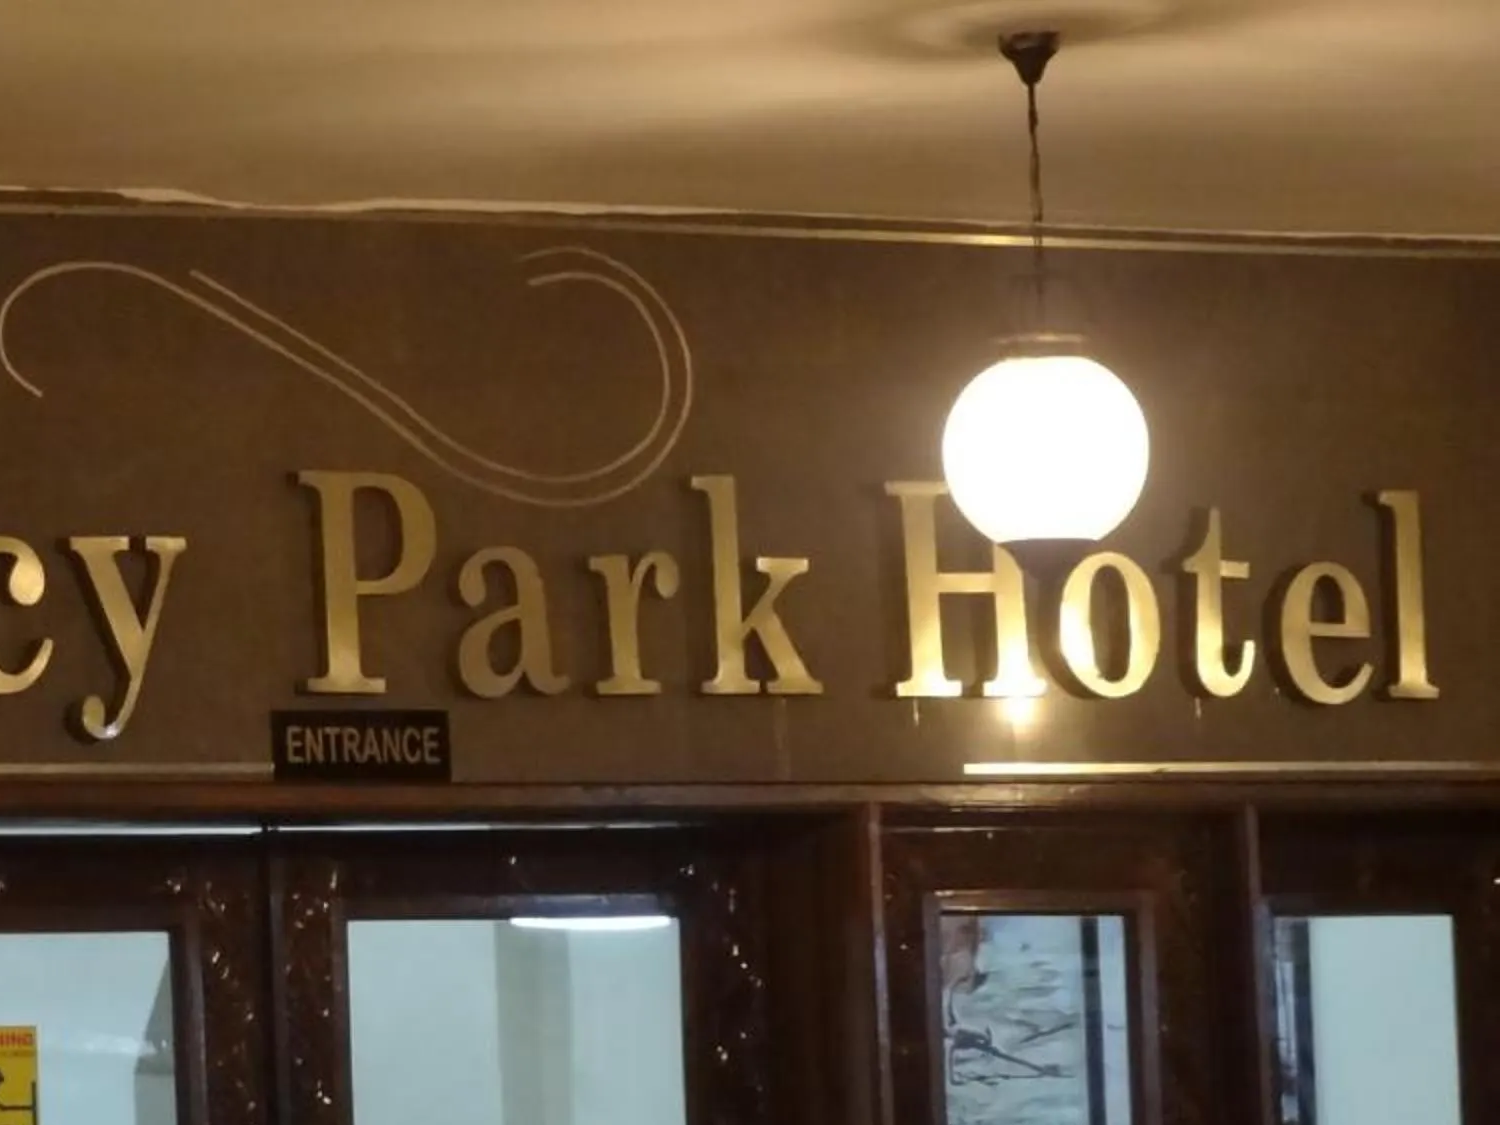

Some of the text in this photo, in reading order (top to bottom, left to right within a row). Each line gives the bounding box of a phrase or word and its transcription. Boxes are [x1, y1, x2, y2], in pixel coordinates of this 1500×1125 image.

[295, 469, 825, 700] Park
[884, 479, 1441, 706] Hotel
[286, 725, 441, 764] ENTRANCE
